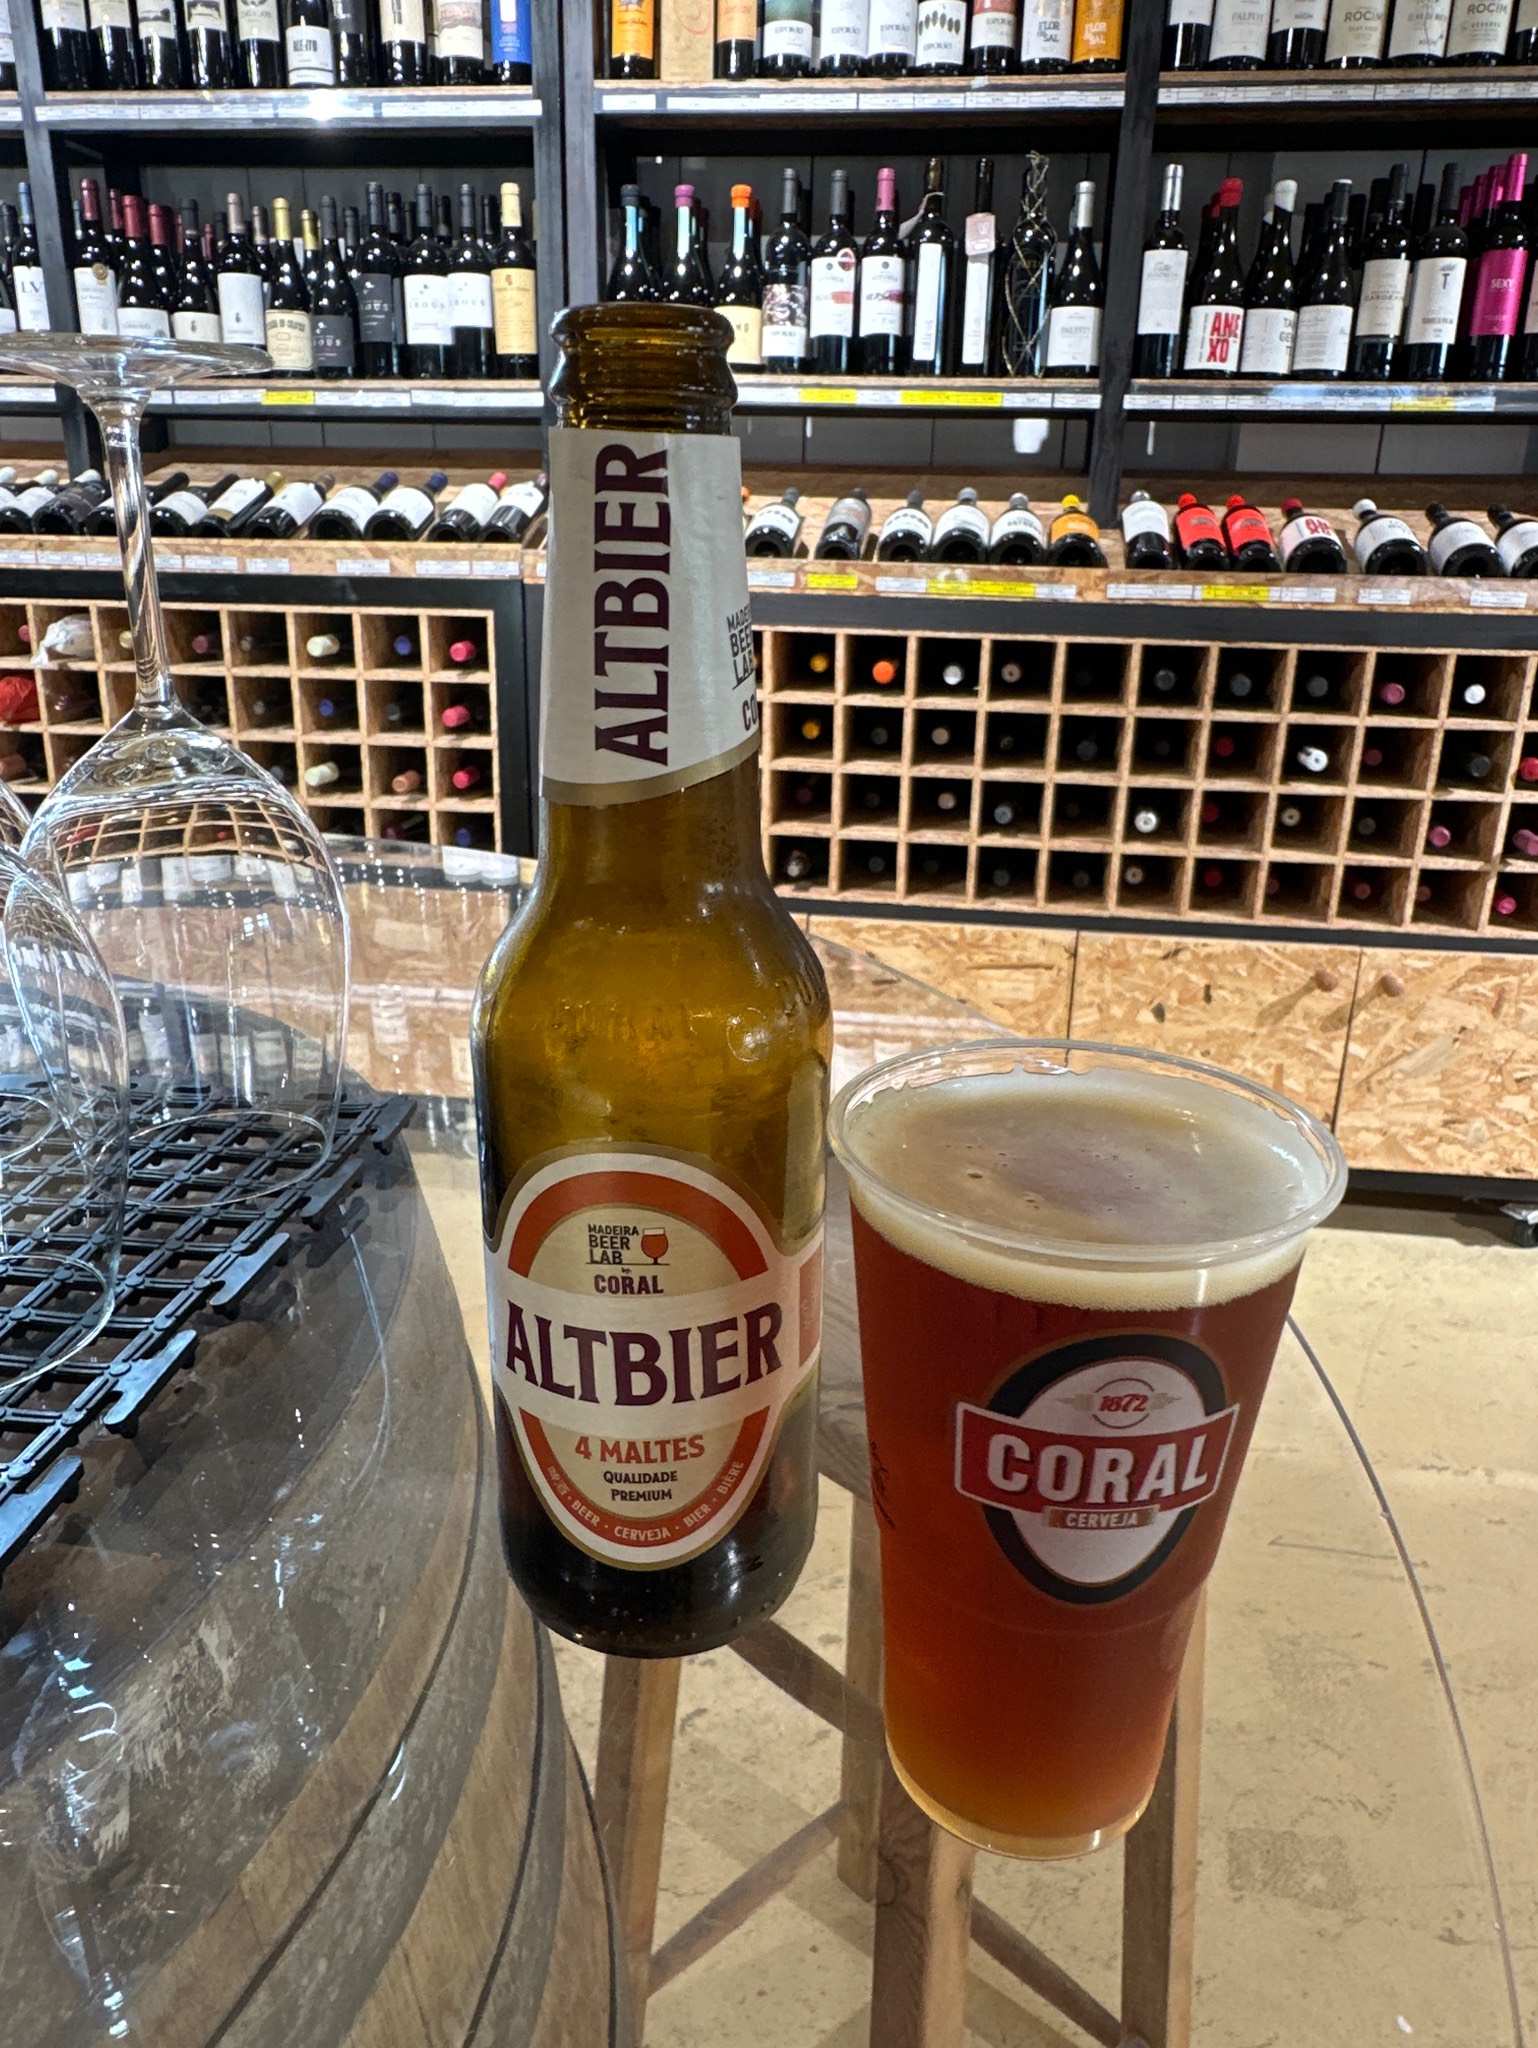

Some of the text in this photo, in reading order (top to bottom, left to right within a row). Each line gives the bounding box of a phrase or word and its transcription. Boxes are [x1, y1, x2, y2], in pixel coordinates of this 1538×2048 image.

[594, 443, 671, 767] ALTBIER
[588, 1223, 640, 1236] MADEIRA
[588, 1235, 631, 1250] BEER
[589, 1249, 623, 1265] LAB
[594, 1273, 664, 1295] CORAL
[505, 1299, 784, 1407] ALTBIER
[1099, 1393, 1149, 1413] 1872
[575, 1434, 706, 1465] 4 MALTES
[603, 1470, 678, 1485] QUALIDADE
[986, 1432, 1208, 1504] CORAL
[611, 1488, 673, 1502] PREMIUM
[571, 1499, 601, 1527] BEER
[613, 1525, 672, 1542] CERVEJA
[682, 1502, 712, 1529] BIER
[1065, 1512, 1138, 1528] CERVEJA
